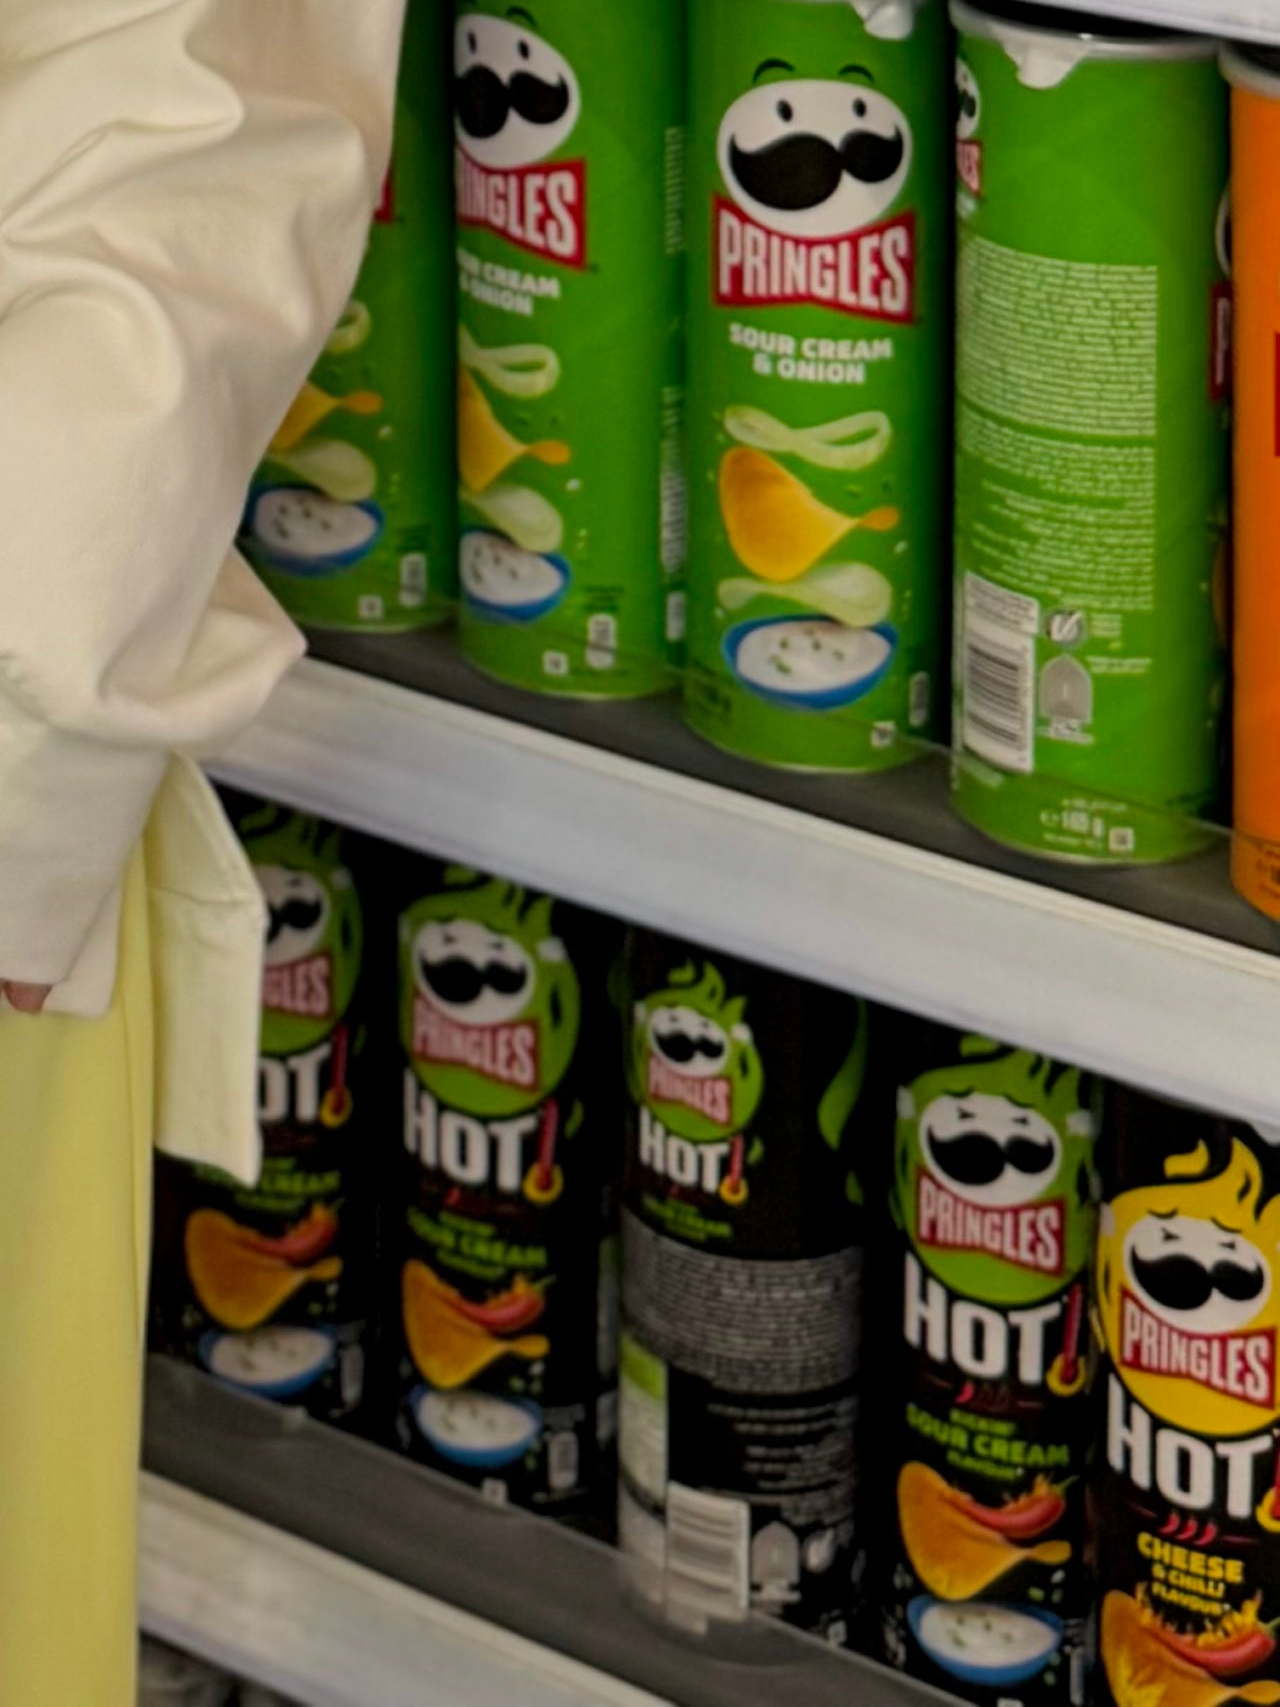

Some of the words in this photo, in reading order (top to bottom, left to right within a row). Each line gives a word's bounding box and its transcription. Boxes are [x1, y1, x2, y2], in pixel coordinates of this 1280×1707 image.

[482, 261, 562, 301] CREAM
[719, 206, 909, 316] PRINGLES
[729, 322, 796, 358] SOUR
[800, 335, 894, 361] CREAM
[752, 351, 771, 376] &
[776, 356, 866, 384] ONION
[259, 1040, 332, 1124] OT
[403, 1065, 537, 1193] HOT
[640, 1103, 730, 1194] HOT
[920, 1175, 1061, 1274] PRINGLES
[903, 1249, 1062, 1386] HOT
[1121, 1289, 1276, 1410] PRINGLES
[972, 1434, 1072, 1469] CREAM
[1107, 1371, 1274, 1518] HOT
[1137, 1530, 1246, 1584] CHEESE
